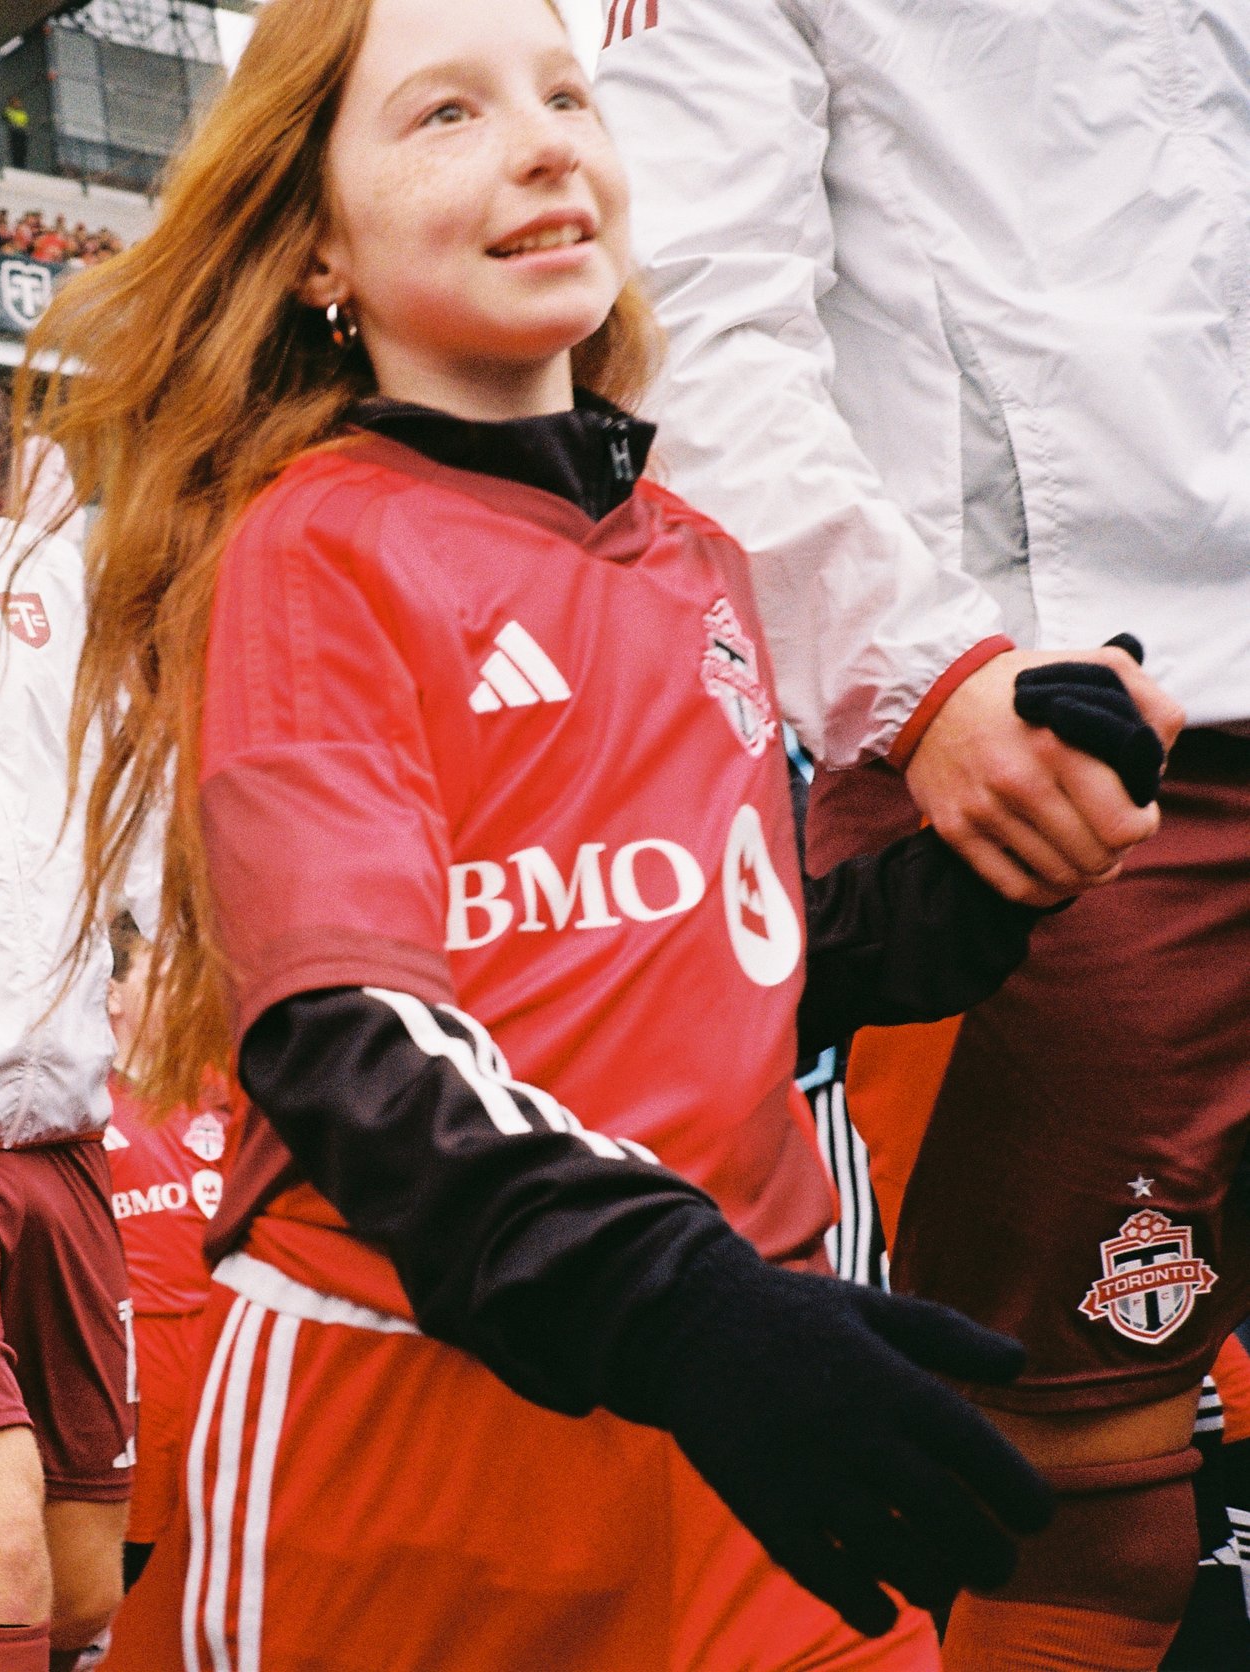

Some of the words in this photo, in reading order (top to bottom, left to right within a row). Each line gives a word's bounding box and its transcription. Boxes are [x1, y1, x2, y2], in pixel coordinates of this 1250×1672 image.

[444, 838, 705, 952] BMO
[111, 1182, 188, 1220] BMO
[1101, 1265, 1195, 1297] TORONTO
